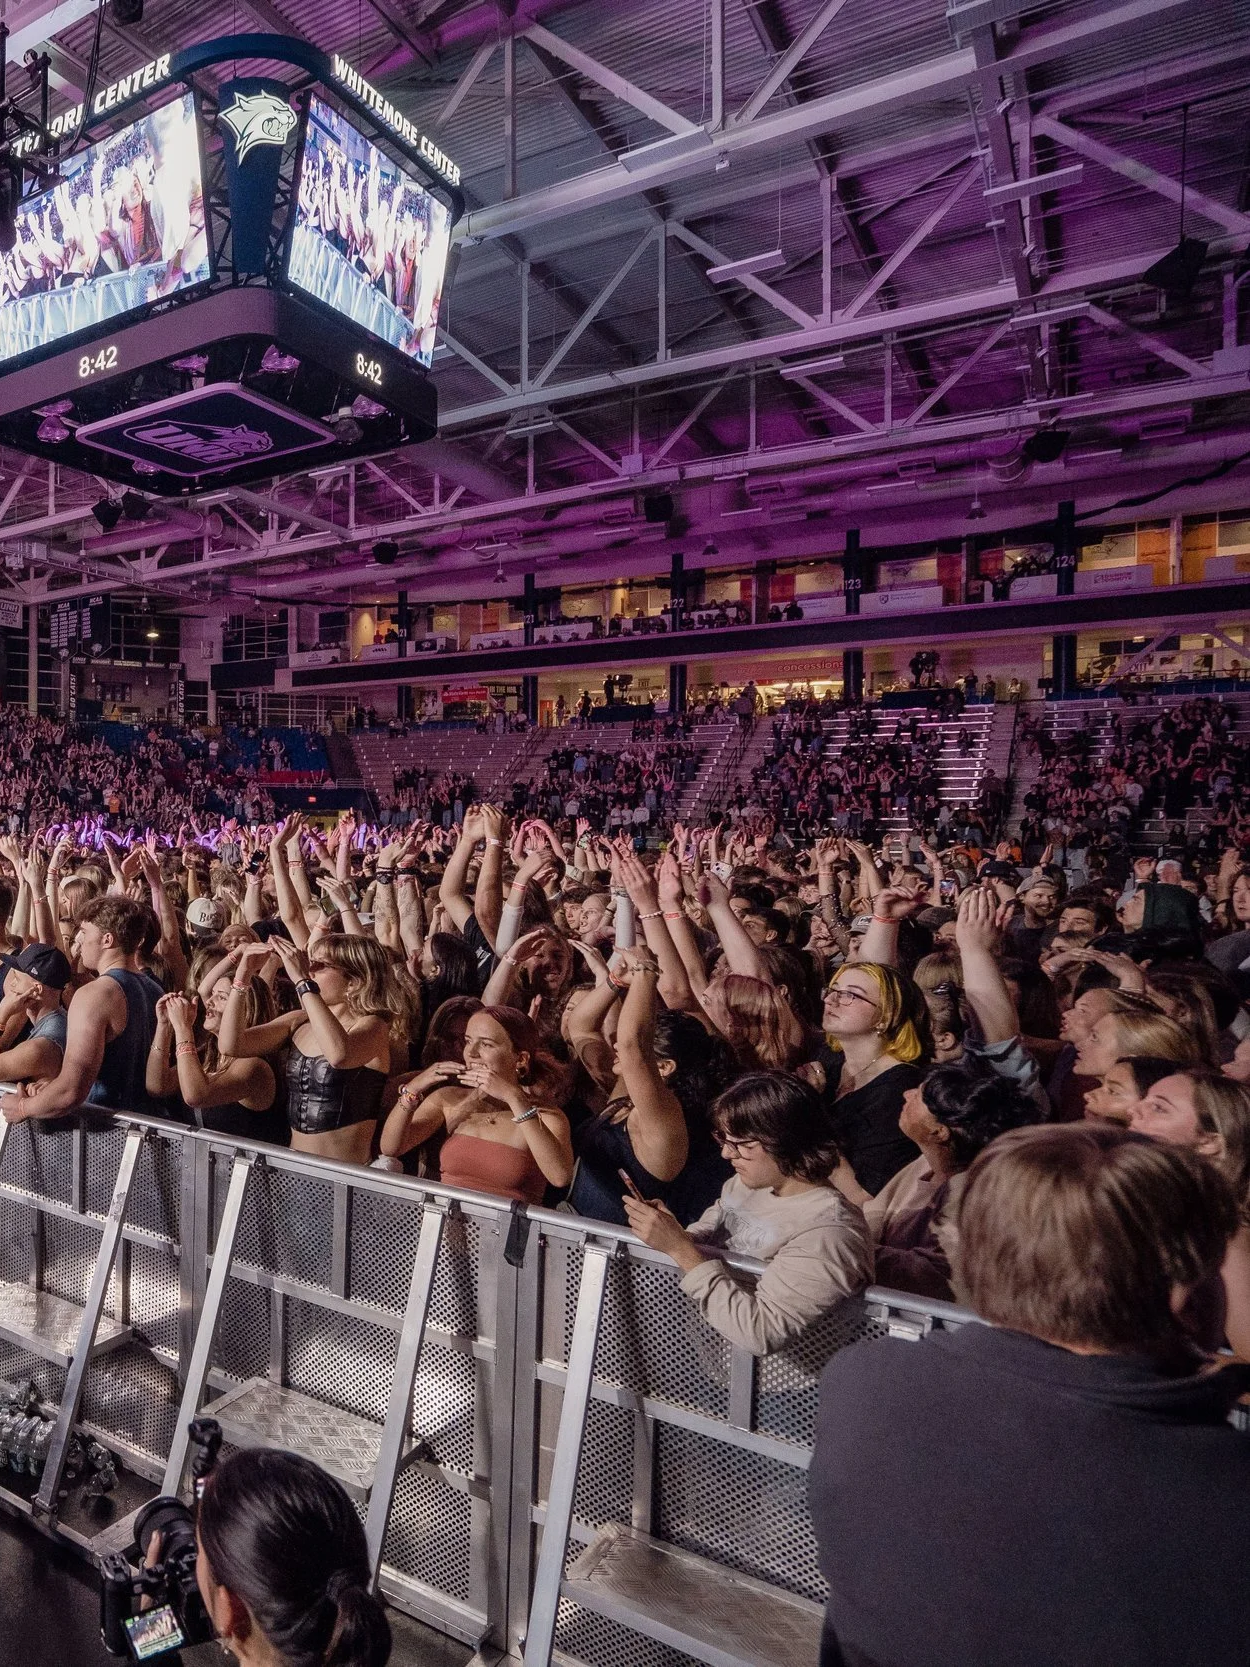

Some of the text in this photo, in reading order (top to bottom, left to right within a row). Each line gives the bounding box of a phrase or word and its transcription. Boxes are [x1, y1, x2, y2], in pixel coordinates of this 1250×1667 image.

[93, 53, 171, 115] CENTER
[334, 53, 461, 187] WHITTEMORE CENTER
[78, 346, 118, 378] 8:42
[356, 353, 383, 385] 8:42
[1055, 555, 1076, 568] 124
[844, 579, 862, 590] 123
[0, 602, 20, 613] UNH
[777, 661, 844, 672] concessions
